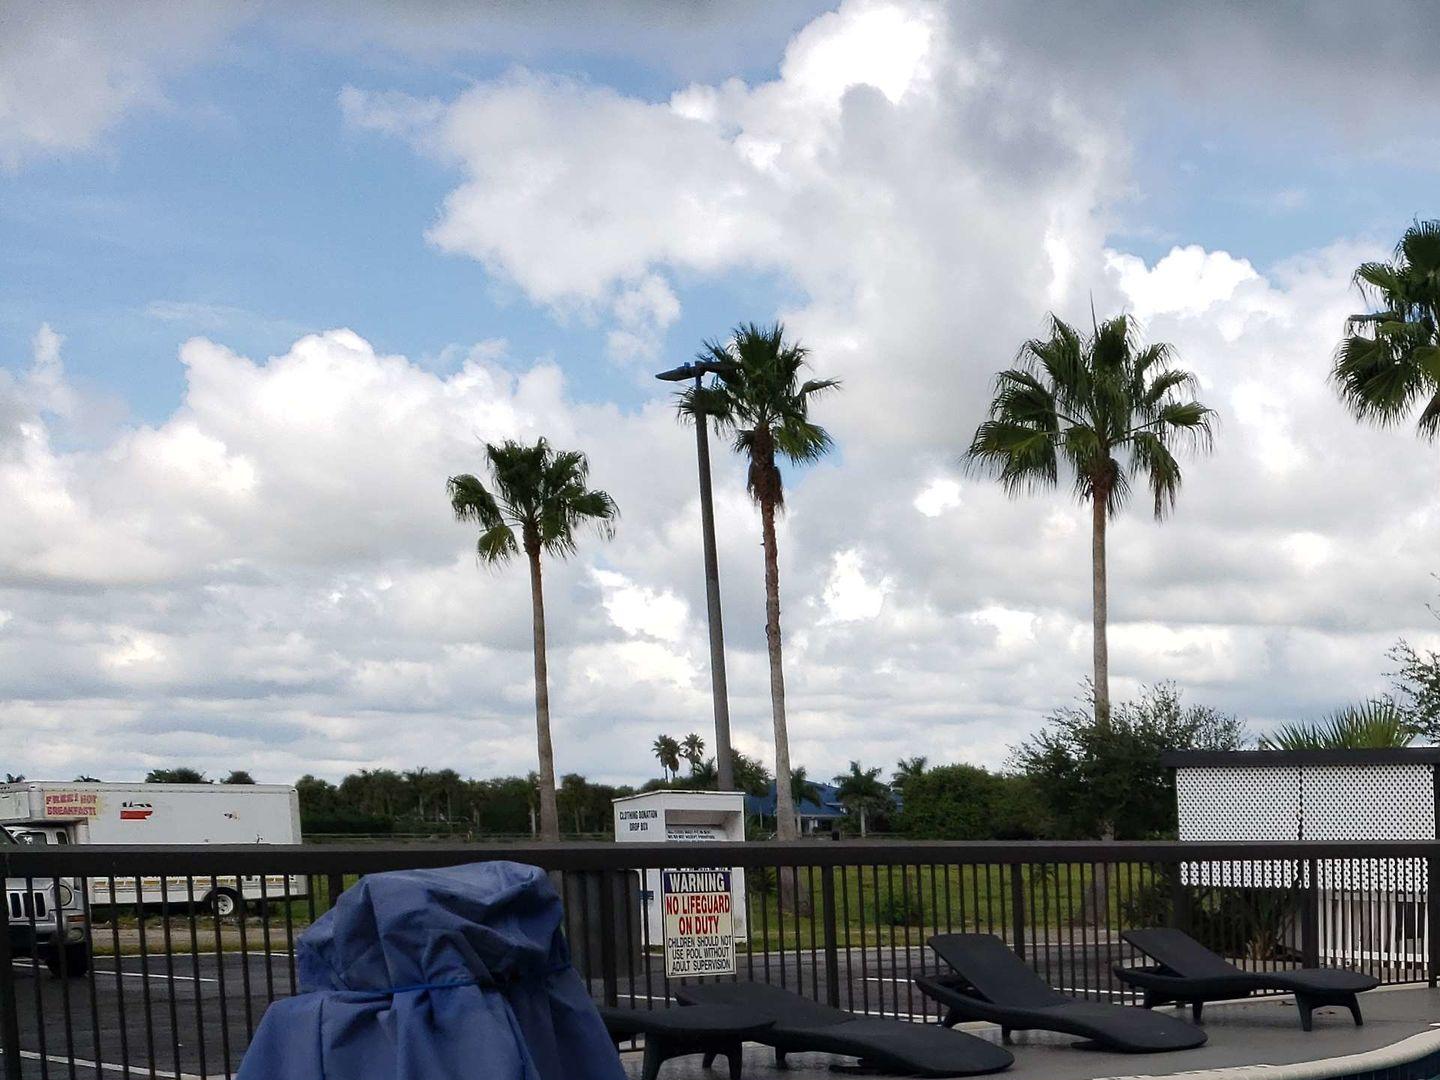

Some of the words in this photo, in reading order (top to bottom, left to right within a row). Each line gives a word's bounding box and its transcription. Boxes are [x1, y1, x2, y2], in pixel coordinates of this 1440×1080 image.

[669, 873, 725, 892] WARNING
[666, 896, 679, 915] NO
[682, 895, 730, 914] LIFEGUARD
[679, 917, 693, 935] ON
[695, 916, 719, 934] DUTY
[668, 937, 696, 948] CHILDREN
[697, 936, 719, 947] SHOULD
[720, 935, 732, 946] NOT
[672, 949, 684, 960] USE
[686, 948, 703, 959] POOL
[704, 947, 729, 958] WITHOUT
[672, 961, 691, 971] ADULT
[693, 959, 731, 970] SUPERVISION
